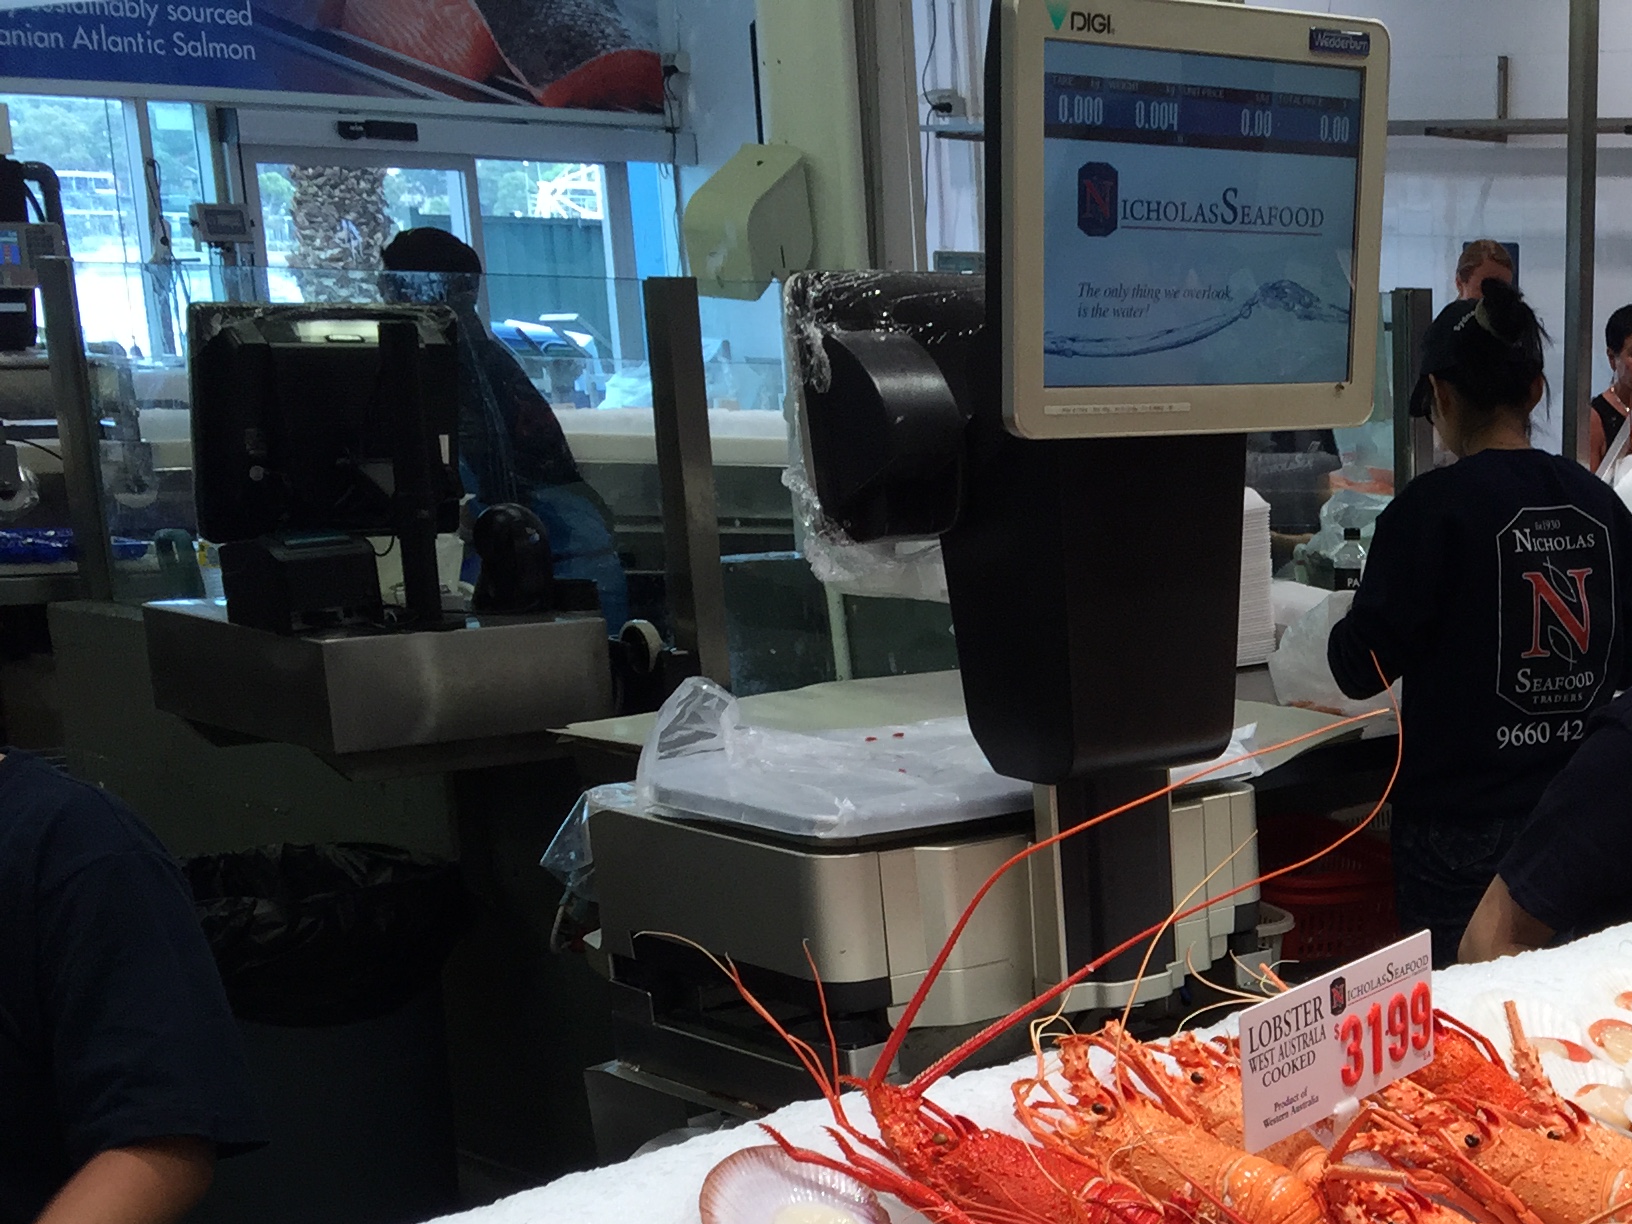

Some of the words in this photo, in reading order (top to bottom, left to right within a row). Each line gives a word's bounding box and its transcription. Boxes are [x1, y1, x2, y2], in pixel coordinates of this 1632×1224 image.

[167, 0, 253, 27] sourced
[1070, 11, 1111, 35] DIGI
[72, 24, 165, 55] Atlantic
[173, 31, 256, 60] Salmon
[1313, 32, 1369, 51] Wedderburn
[1058, 94, 1104, 126] 0.000
[1135, 100, 1179, 131] 0.004
[1240, 108, 1272, 138] 0.00
[1320, 115, 1350, 143] 0.00
[1078, 282, 1101, 298] The
[1104, 282, 1130, 301] only
[1132, 283, 1161, 302] thing
[1164, 289, 1181, 299] we
[1077, 302, 1088, 318] is
[1091, 303, 1110, 318] the
[1113, 303, 1150, 319] water!
[1512, 528, 1595, 553] NICHOLAS
[1521, 567, 1593, 658] N
[1515, 668, 1595, 693] SEAFOOD
[1532, 693, 1583, 704] TRADERS
[1496, 721, 1551, 750] 9660
[1248, 995, 1325, 1055] LOBSTER
[1248, 1047, 1275, 1075] WEST
[1278, 1024, 1327, 1063] AUSTRALA
[1262, 1050, 1316, 1087] COOKED
[1263, 1109, 1289, 1128] Western
[1290, 1094, 1319, 1116] Australia
[1274, 1093, 1300, 1113] Product
[1300, 1086, 1308, 1099] of
